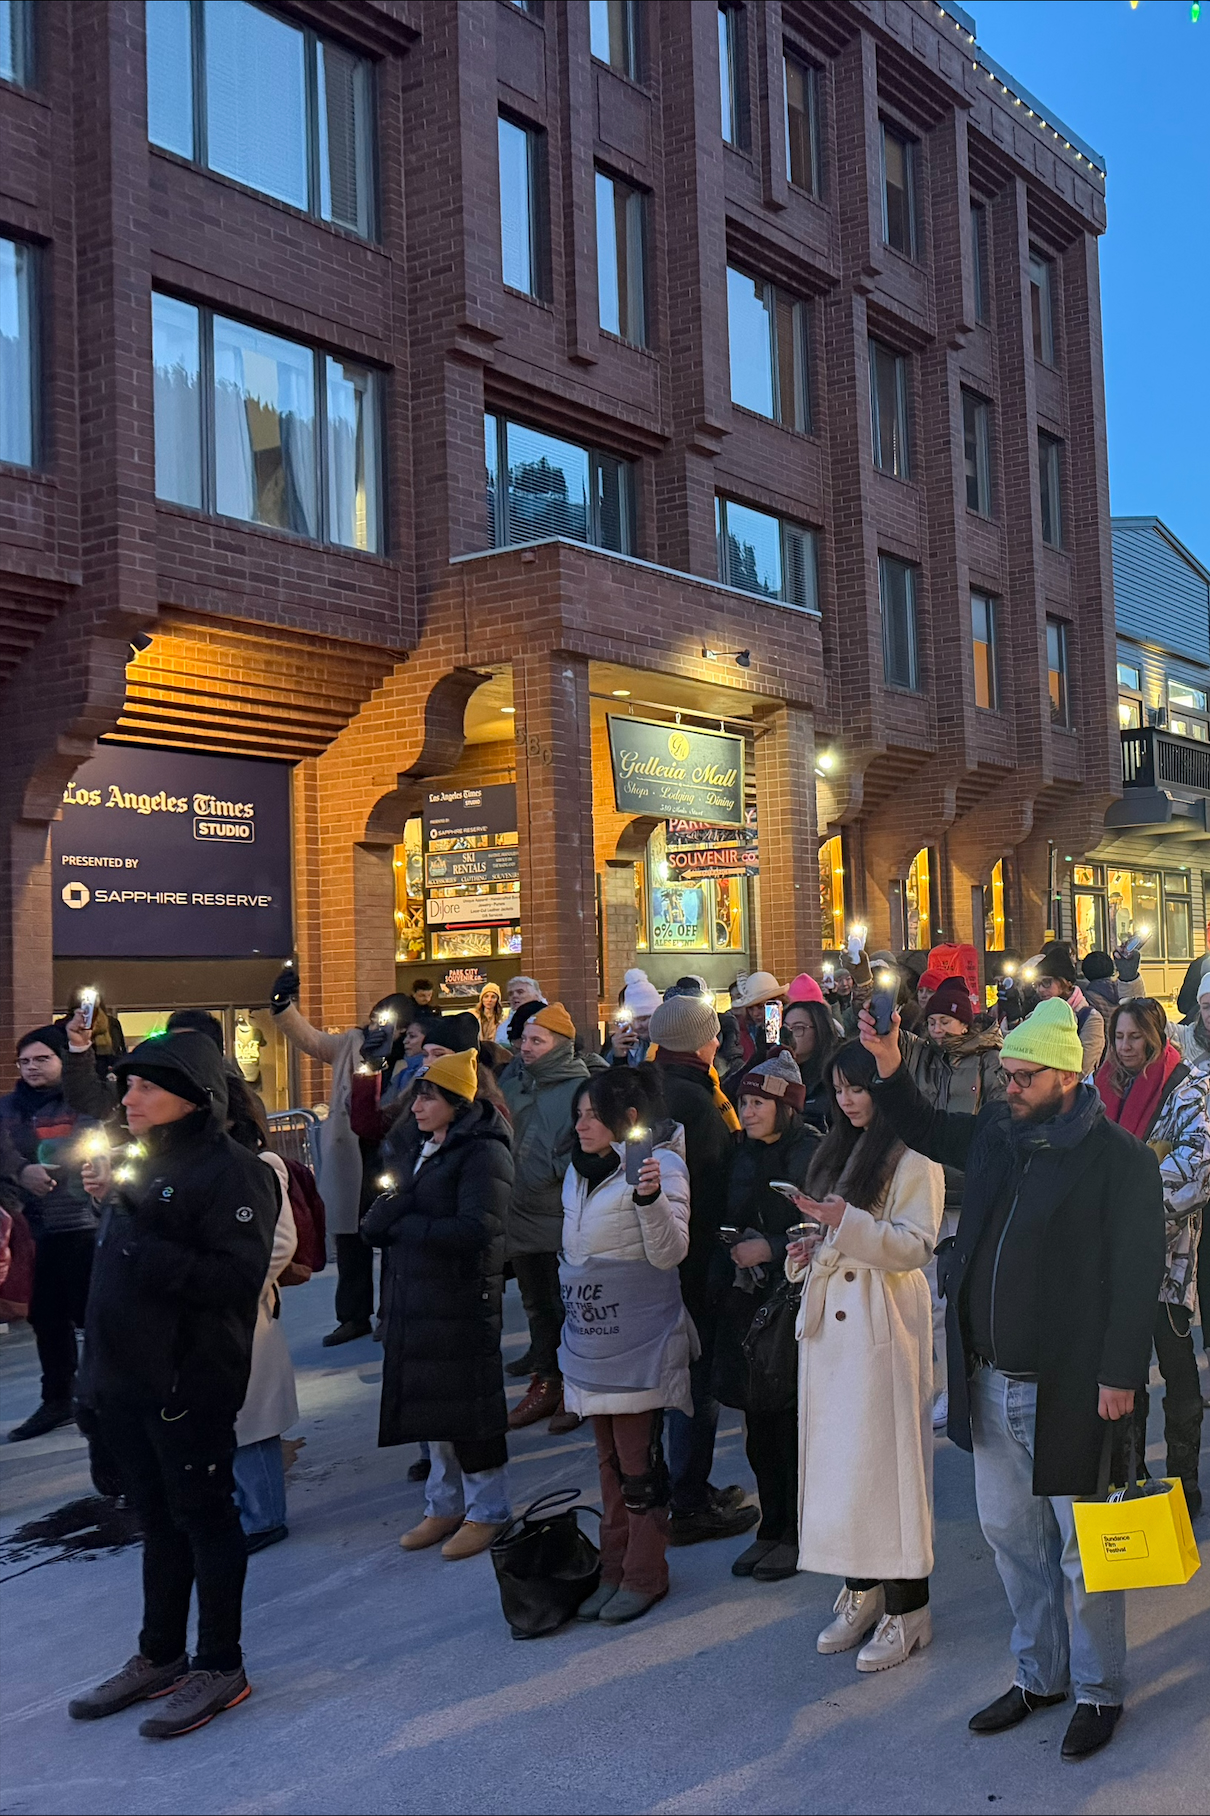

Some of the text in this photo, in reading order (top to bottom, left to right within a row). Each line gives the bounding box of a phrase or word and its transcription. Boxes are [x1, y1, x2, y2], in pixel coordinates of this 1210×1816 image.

[619, 750, 738, 788] Galleria Mall
[63, 782, 254, 818] Los Angeles Times
[623, 781, 735, 812] Shops Lodging Dining
[199, 822, 250, 838] STUDIO
[62, 855, 138, 869] PRESENTED BY
[462, 852, 476, 863] SKI
[669, 850, 738, 868] SOUVENIR
[453, 862, 487, 875] RENTALS
[461, 875, 487, 883] CLOTHING
[95, 890, 187, 905] SAPPHIRE
[654, 923, 697, 938] 0% OFF
[445, 974, 474, 983] SOUVENIR
[578, 1284, 603, 1301] ICE
[582, 1303, 620, 1322] OUT
[579, 1326, 620, 1335] EAPOLIS
